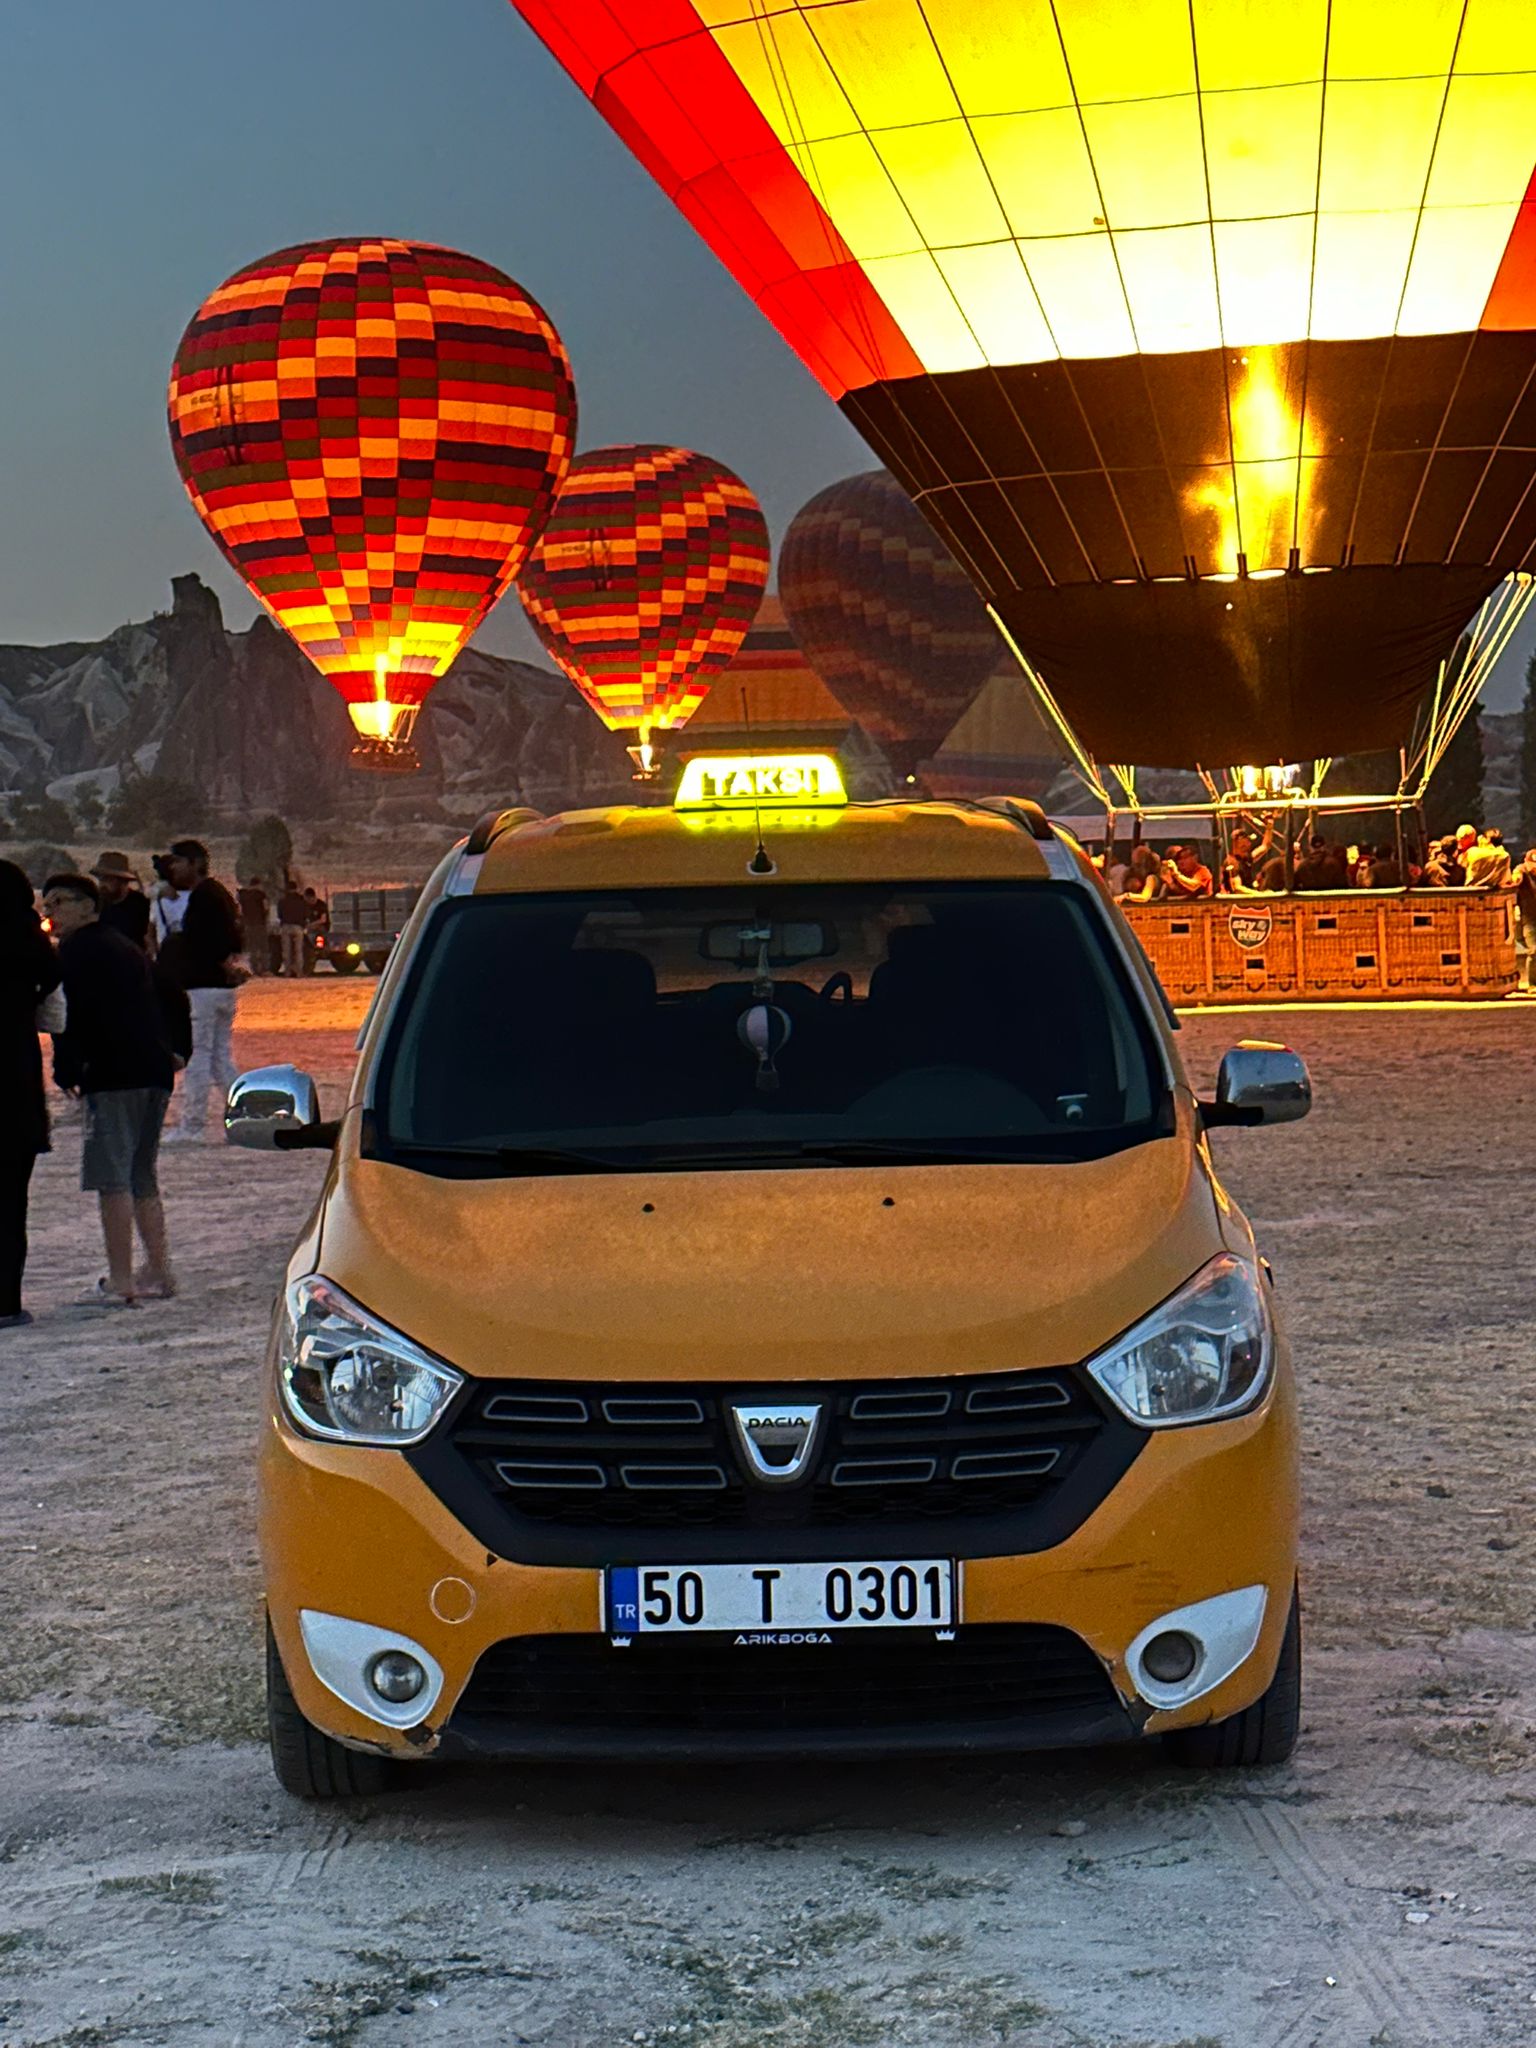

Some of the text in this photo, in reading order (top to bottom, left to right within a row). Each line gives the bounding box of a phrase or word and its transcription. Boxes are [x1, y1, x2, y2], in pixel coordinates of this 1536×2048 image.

[748, 1417, 807, 1428] DACIA
[644, 1566, 941, 1625] 50 T 0301
[615, 1604, 636, 1619] TR
